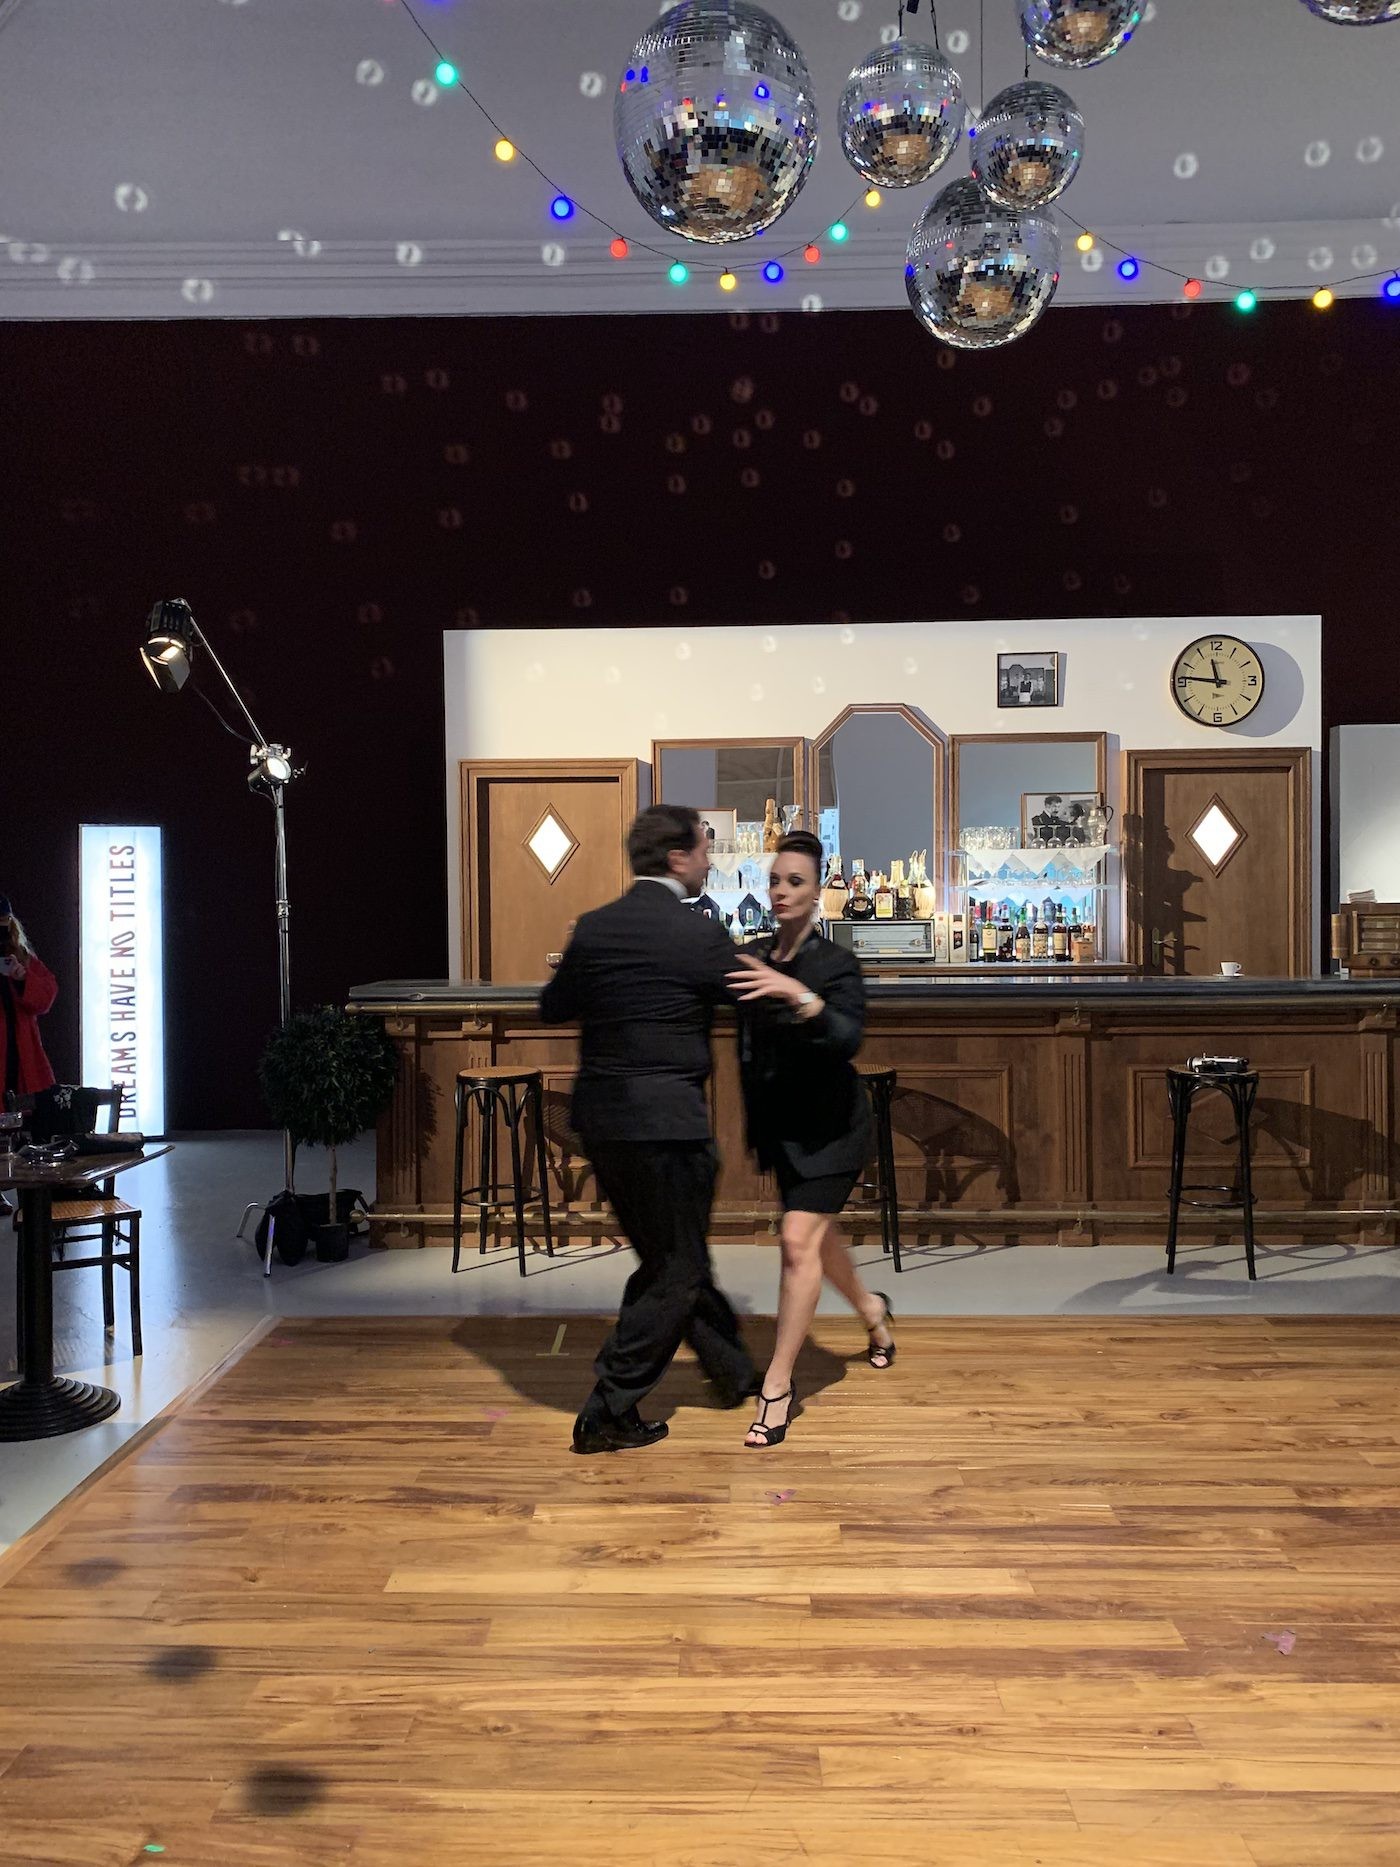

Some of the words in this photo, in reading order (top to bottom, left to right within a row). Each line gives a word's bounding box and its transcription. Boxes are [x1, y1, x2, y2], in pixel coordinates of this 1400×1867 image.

[1210, 641, 1223, 651] 12
[1177, 677, 1187, 687] 9
[1247, 675, 1257, 686] 3
[1213, 712, 1223, 722] 6
[109, 844, 135, 921] TITLES
[110, 930, 136, 958] NO
[110, 968, 136, 1021] HAVE
